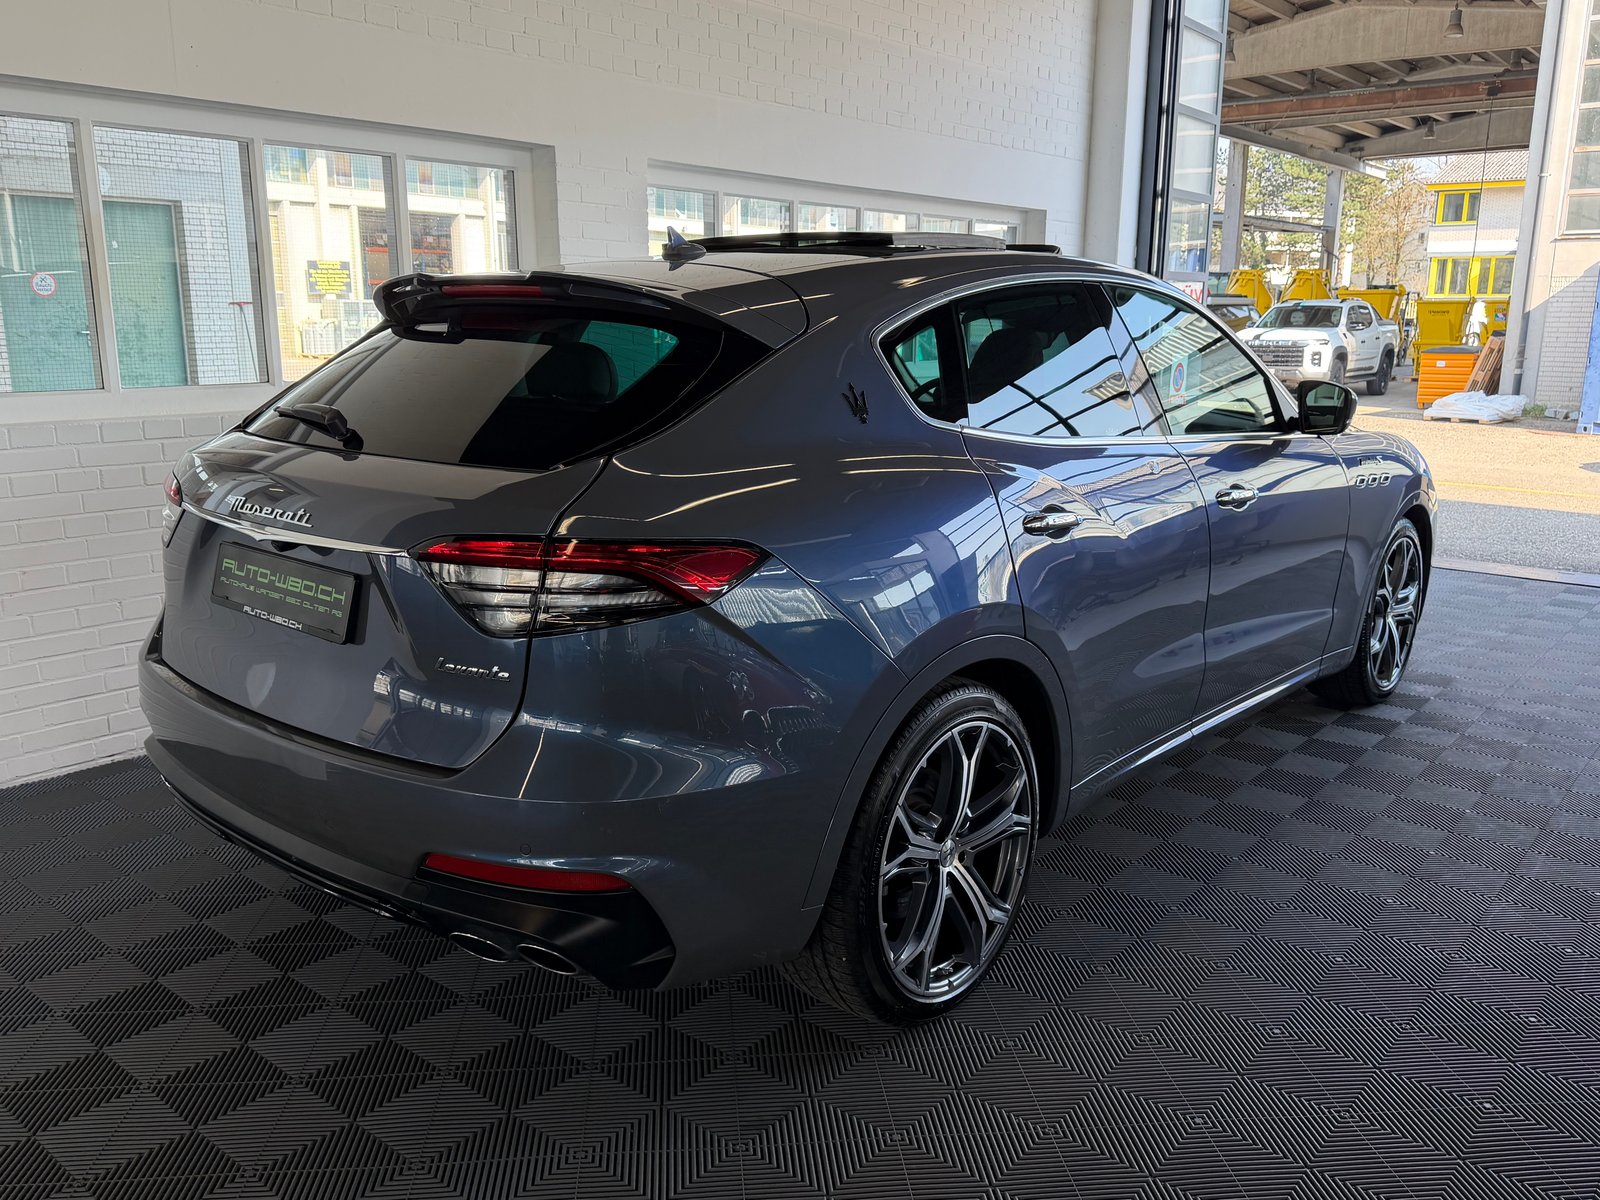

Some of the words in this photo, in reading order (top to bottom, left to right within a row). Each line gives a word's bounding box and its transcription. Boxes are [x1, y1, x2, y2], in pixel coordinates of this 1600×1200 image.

[229, 496, 313, 527] Maserati
[331, 609, 343, 618] AG
[435, 657, 511, 682] Levante
